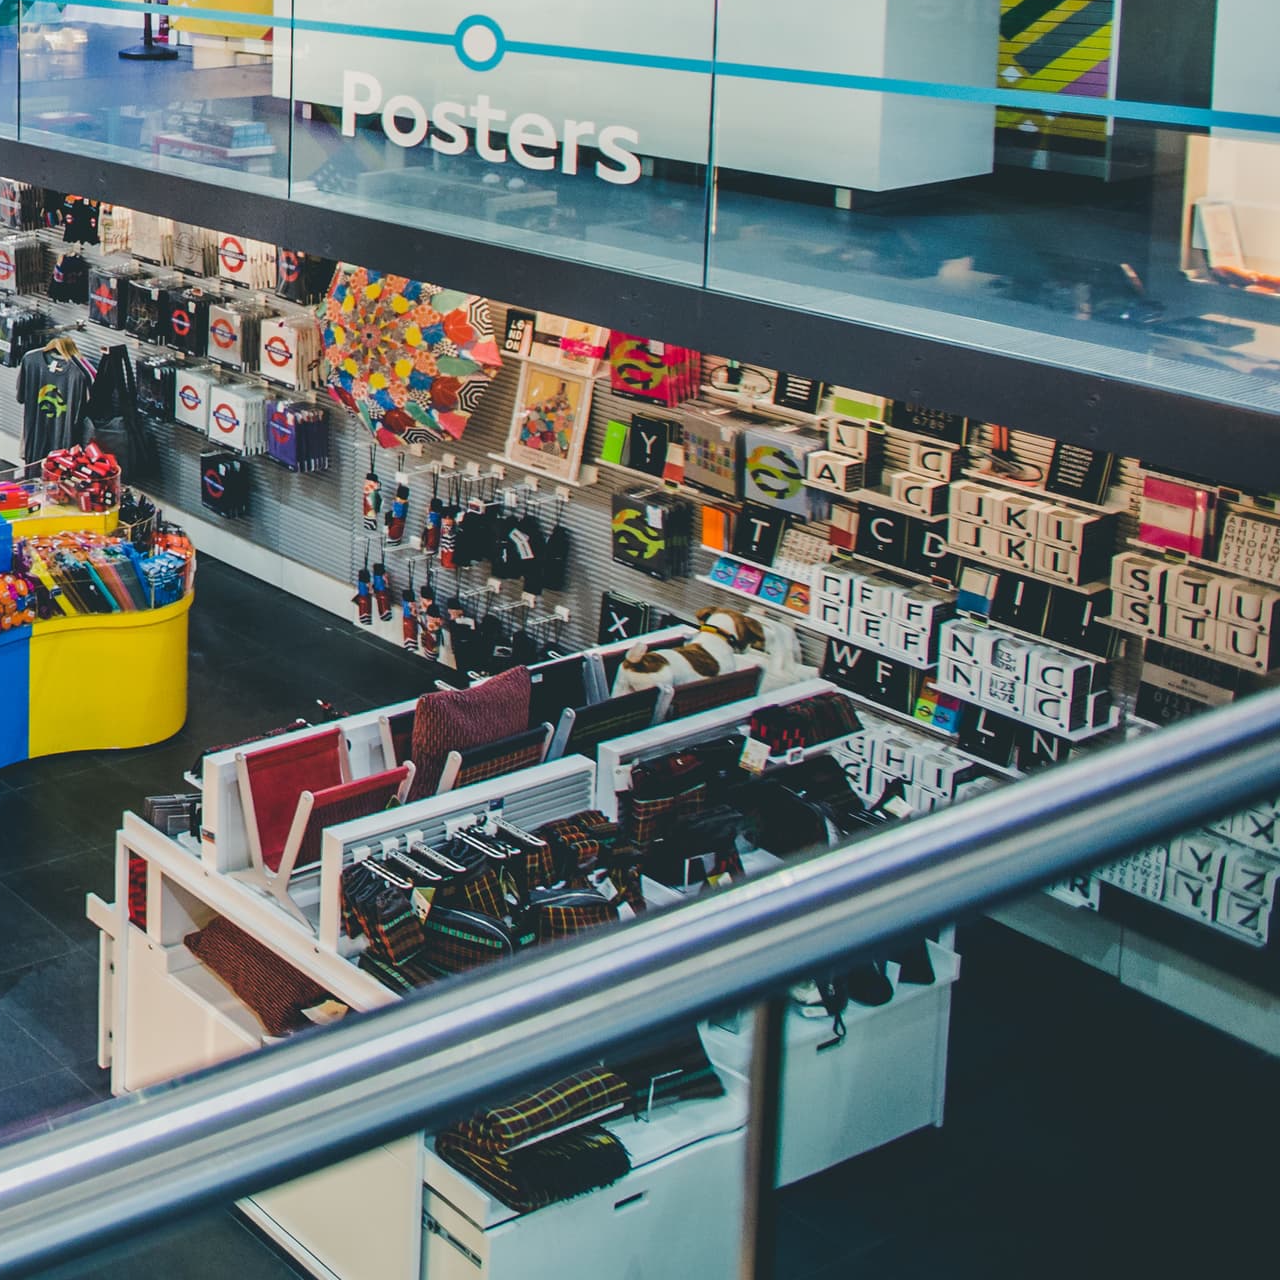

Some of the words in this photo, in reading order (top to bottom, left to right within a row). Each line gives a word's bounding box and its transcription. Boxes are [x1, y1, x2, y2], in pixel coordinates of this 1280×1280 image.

[342, 69, 642, 186] Posters
[641, 431, 657, 455] Y
[818, 463, 837, 484] A
[921, 451, 943, 472] C
[905, 486, 923, 506] C
[750, 518, 770, 543] T
[871, 517, 894, 544] C
[1007, 507, 1026, 530] K
[922, 531, 948, 558] D
[1007, 538, 1025, 560] K
[1129, 568, 1150, 592] S
[1183, 580, 1207, 605] T
[907, 603, 924, 620] F
[1129, 602, 1150, 625] S
[1236, 594, 1262, 620] U
[607, 611, 629, 638] X
[865, 618, 882, 640] E
[1182, 615, 1206, 640] T
[831, 640, 862, 668] W
[904, 633, 920, 651] F
[952, 633, 974, 657] N
[1232, 629, 1258, 657] U
[876, 660, 893, 684] F
[952, 664, 972, 686] N
[1041, 666, 1065, 689] C
[1038, 698, 1061, 721] C
[976, 708, 996, 737] L
[1032, 729, 1059, 761] N
[1249, 813, 1275, 844] X
[1189, 846, 1213, 872] Y
[1185, 880, 1204, 908] Y
[1241, 868, 1267, 896] Z
[1235, 902, 1260, 931] Z
